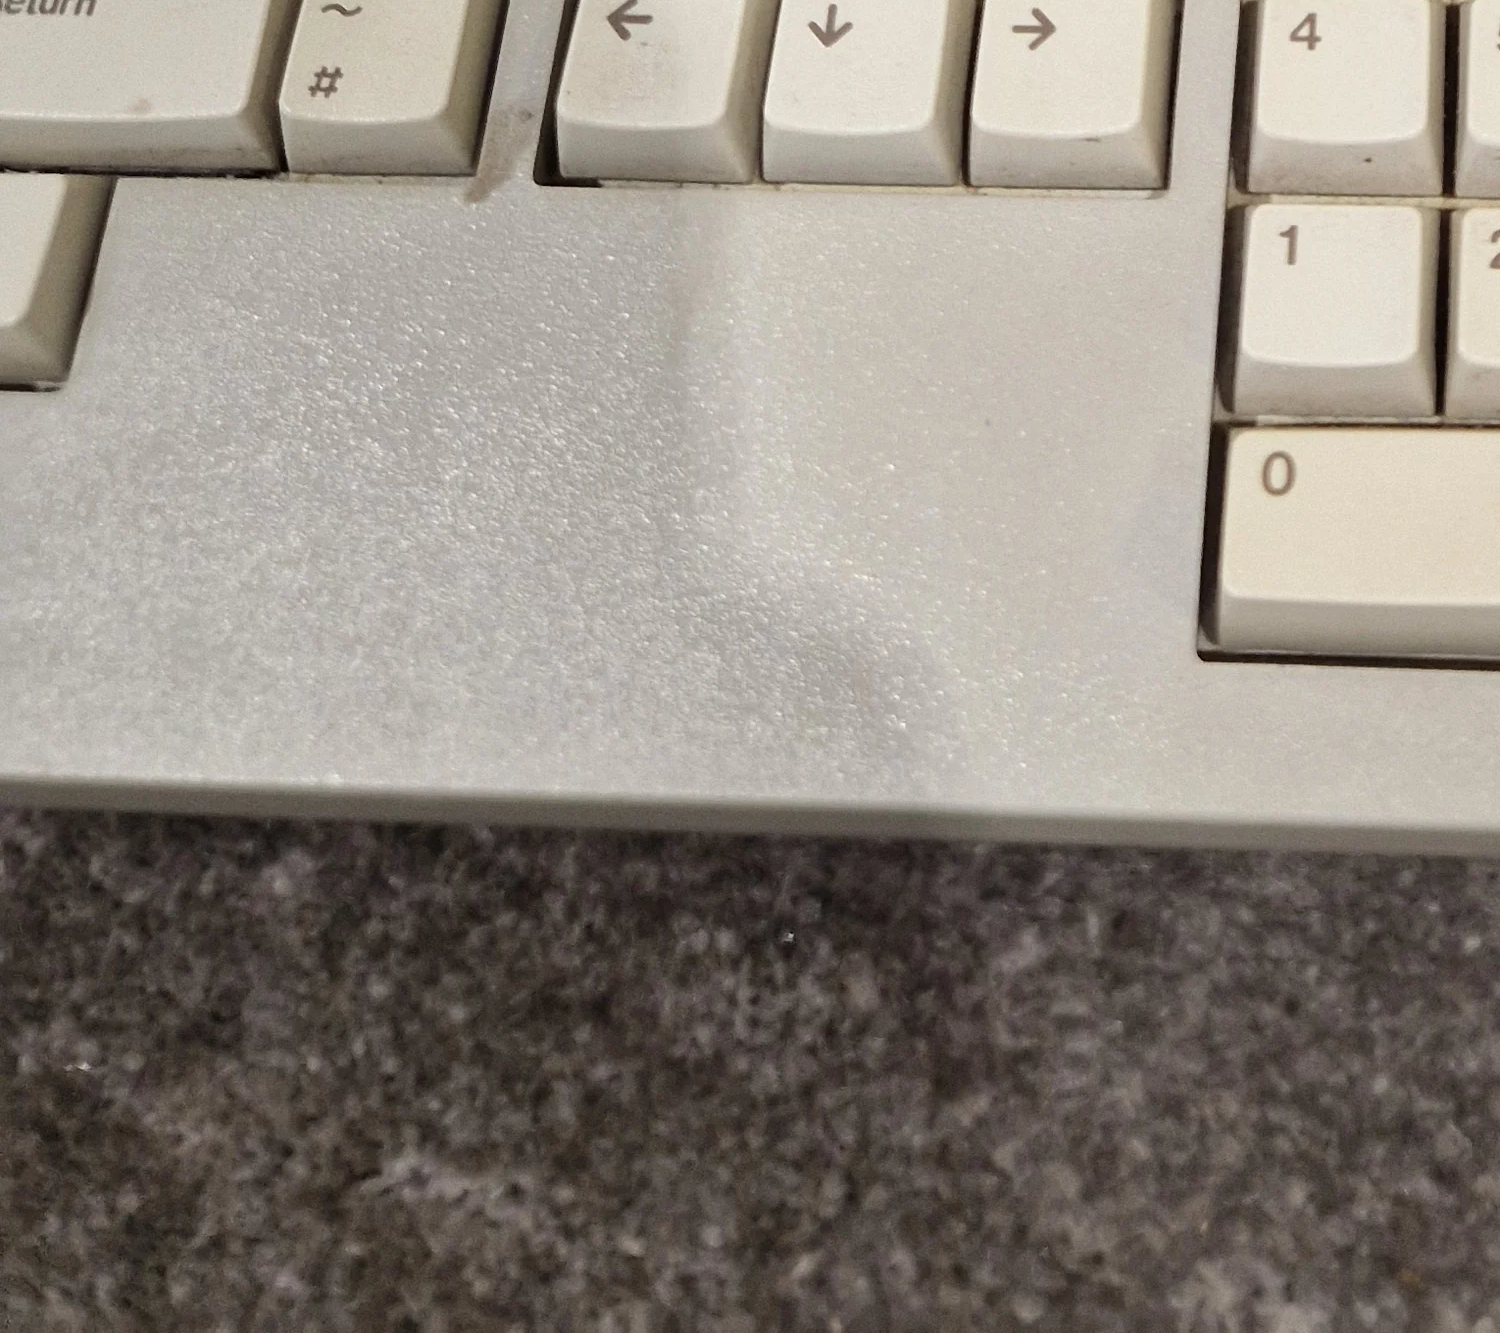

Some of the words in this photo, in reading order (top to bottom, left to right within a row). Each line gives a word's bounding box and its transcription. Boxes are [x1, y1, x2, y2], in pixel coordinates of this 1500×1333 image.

[1289, 12, 1322, 51] 4
[1279, 224, 1298, 266] 1
[1261, 451, 1296, 497] 0
